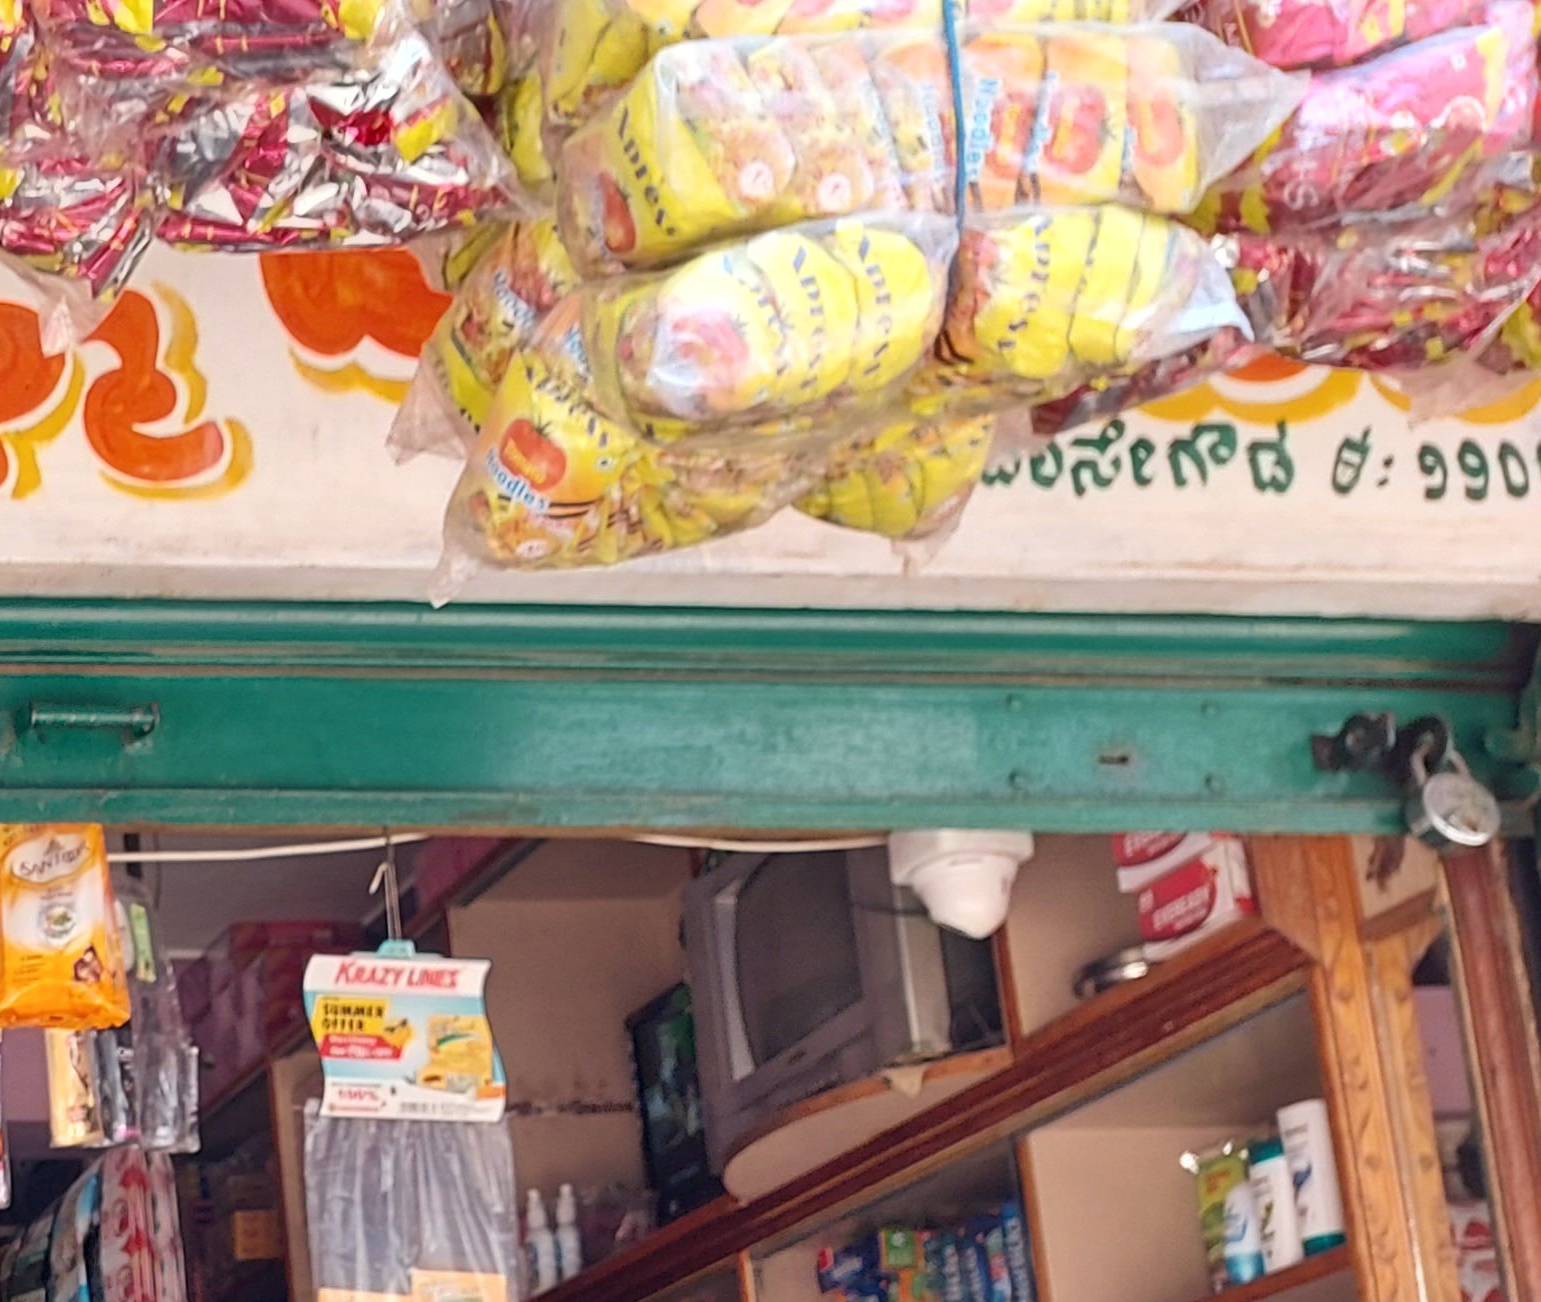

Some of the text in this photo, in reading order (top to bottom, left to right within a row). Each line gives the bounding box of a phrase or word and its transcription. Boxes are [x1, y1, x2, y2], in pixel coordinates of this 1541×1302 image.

[335, 962, 401, 985] KRAZY
[322, 1003, 383, 1017] SUMMER
[322, 1018, 364, 1031] OFFER
